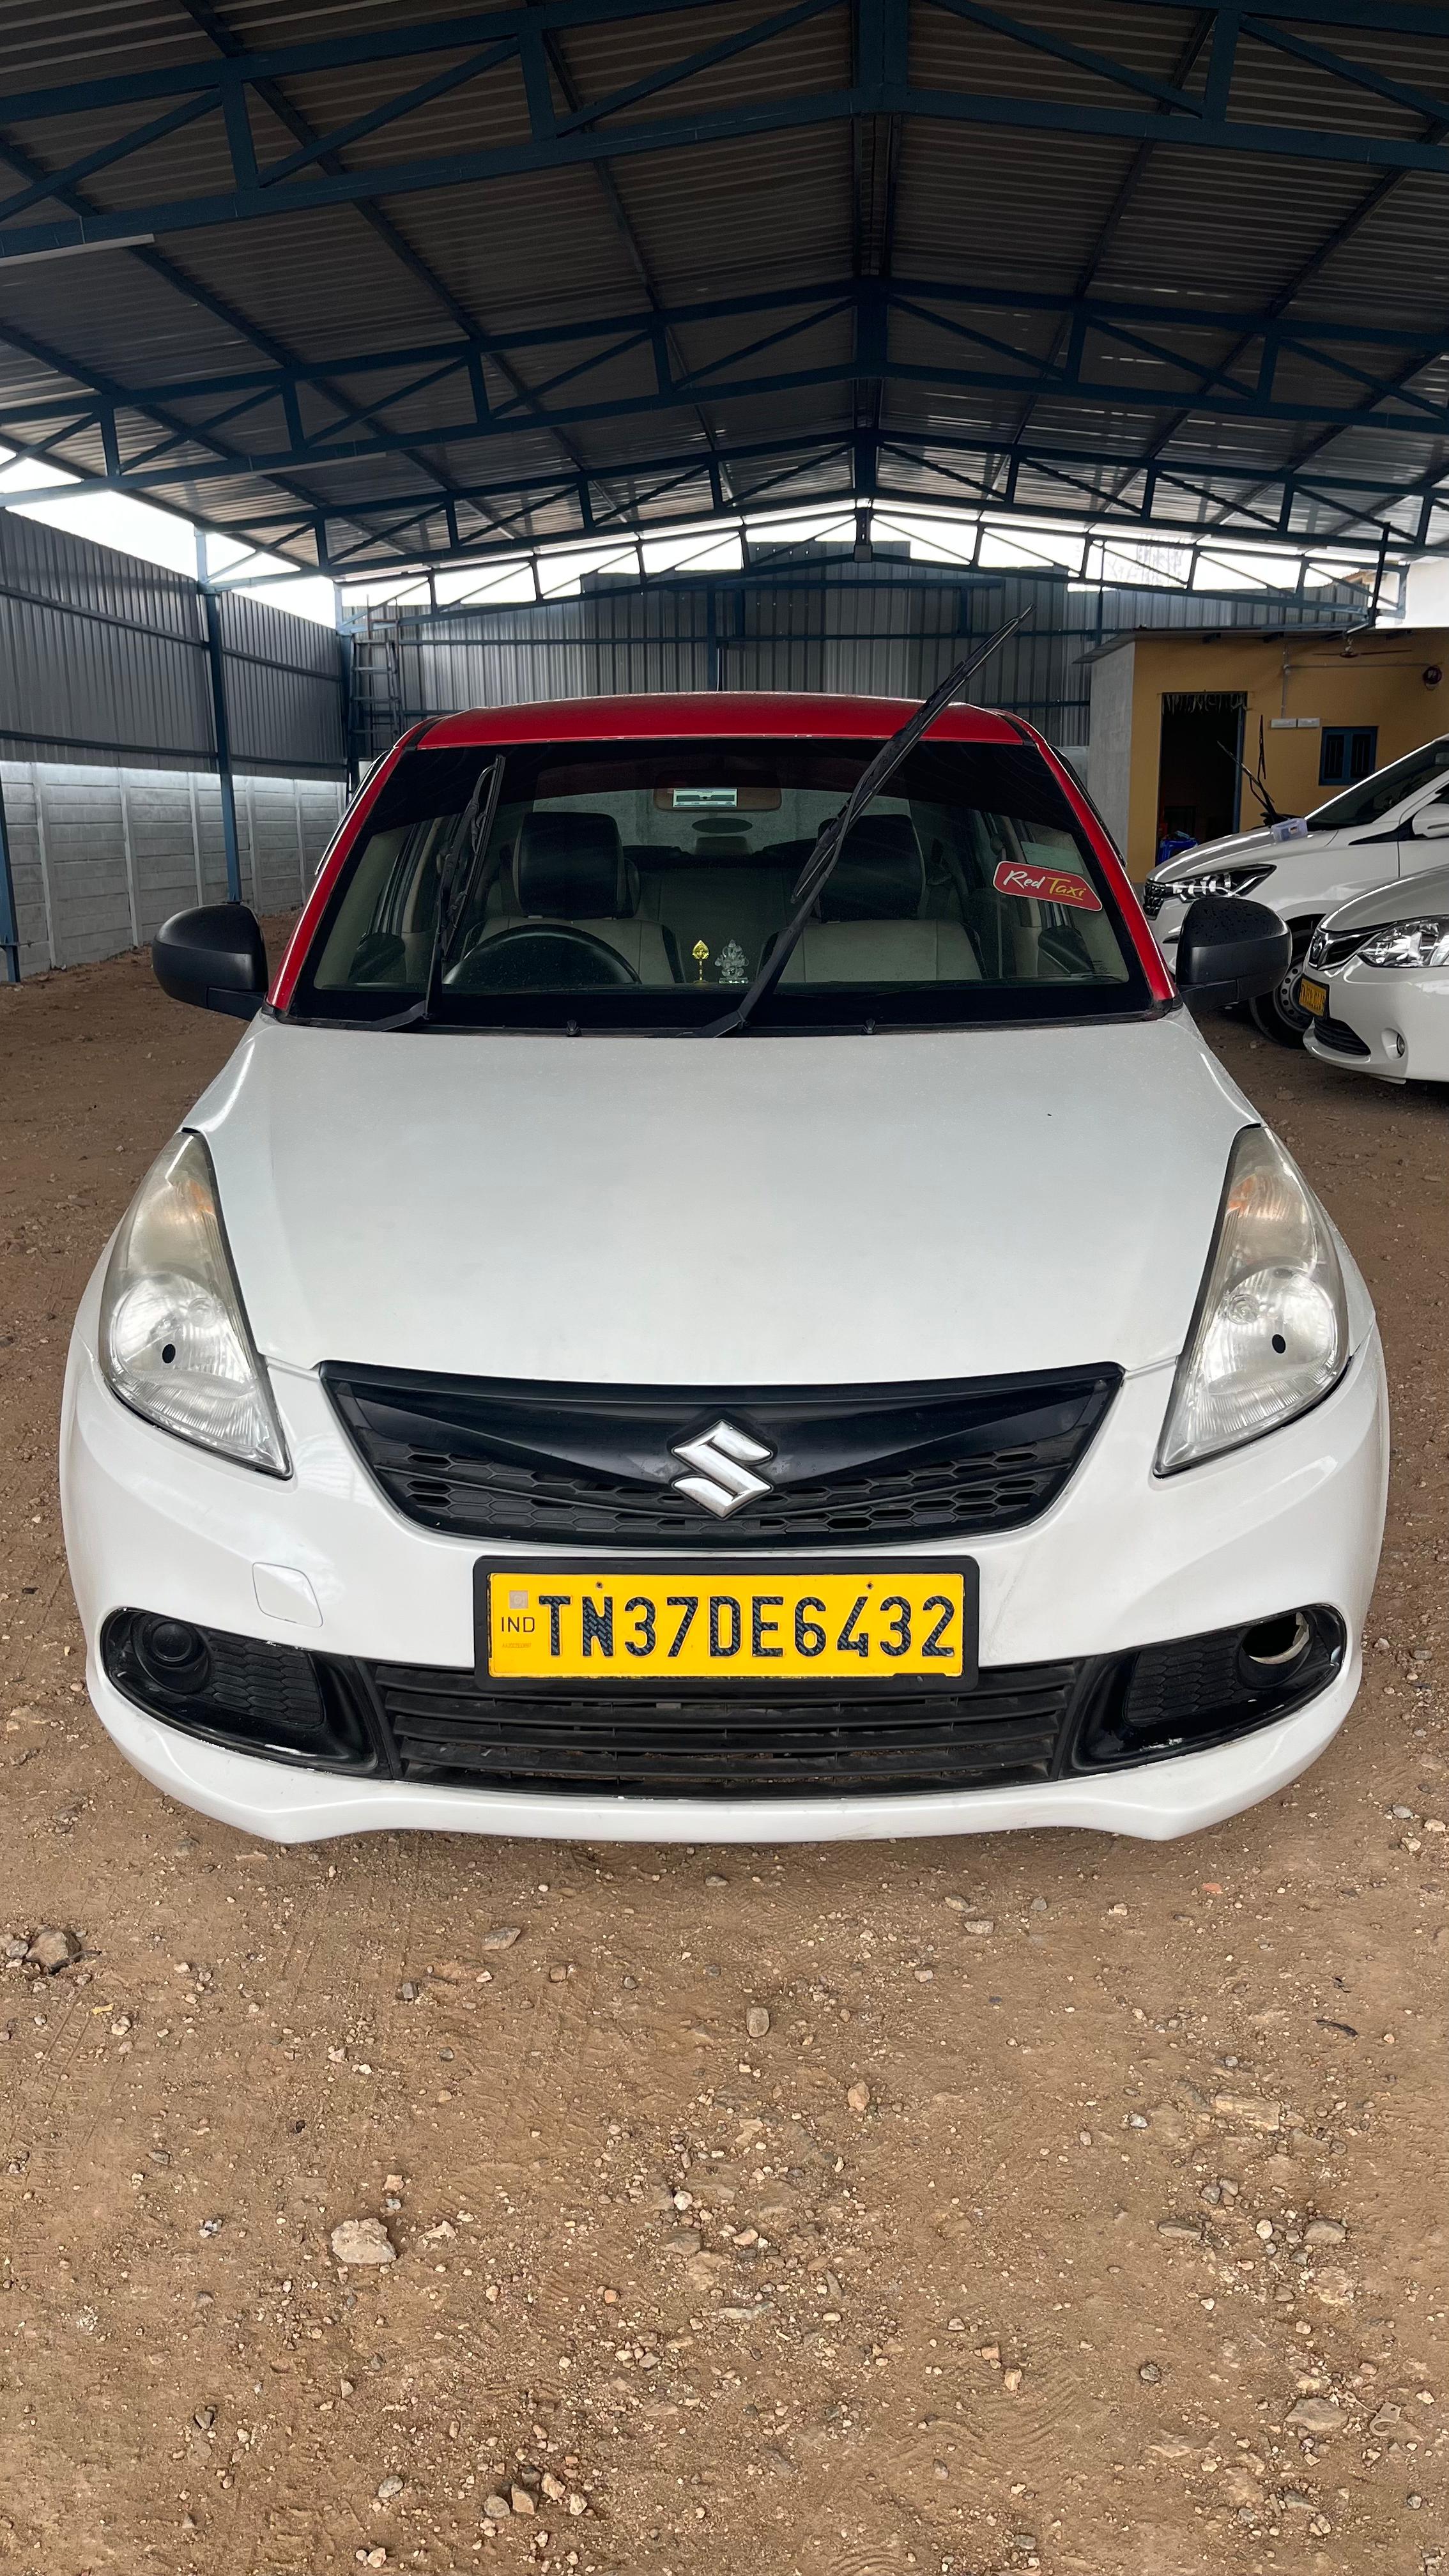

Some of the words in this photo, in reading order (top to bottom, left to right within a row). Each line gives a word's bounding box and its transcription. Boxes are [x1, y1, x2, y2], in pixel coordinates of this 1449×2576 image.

[1002, 870, 1046, 889] Red
[1047, 877, 1087, 897] Taxi
[502, 1616, 535, 1632] IND
[538, 1595, 956, 1657] TN37DE6432
